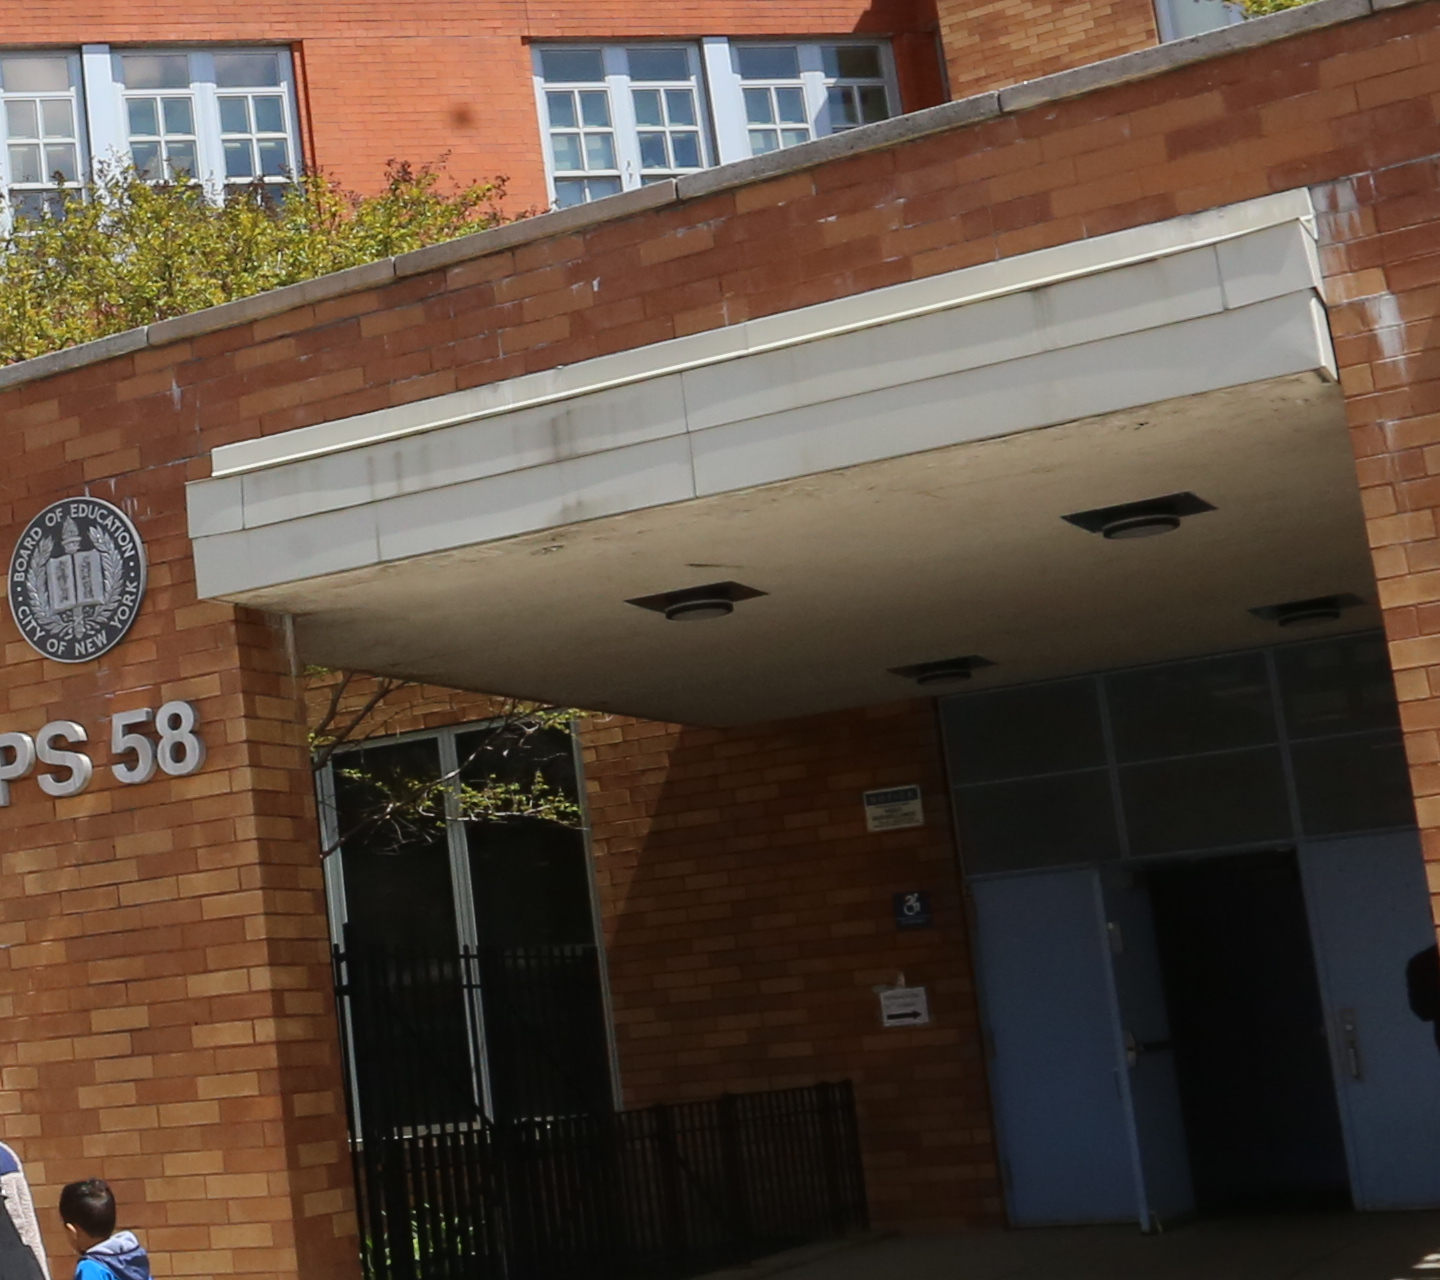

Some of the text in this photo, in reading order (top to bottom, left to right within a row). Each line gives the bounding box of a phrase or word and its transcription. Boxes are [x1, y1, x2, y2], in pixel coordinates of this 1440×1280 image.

[13, 503, 136, 581] BOARD OF EDUCATION
[18, 581, 138, 656] CITY OF NEW YORK
[111, 700, 206, 784] 58
